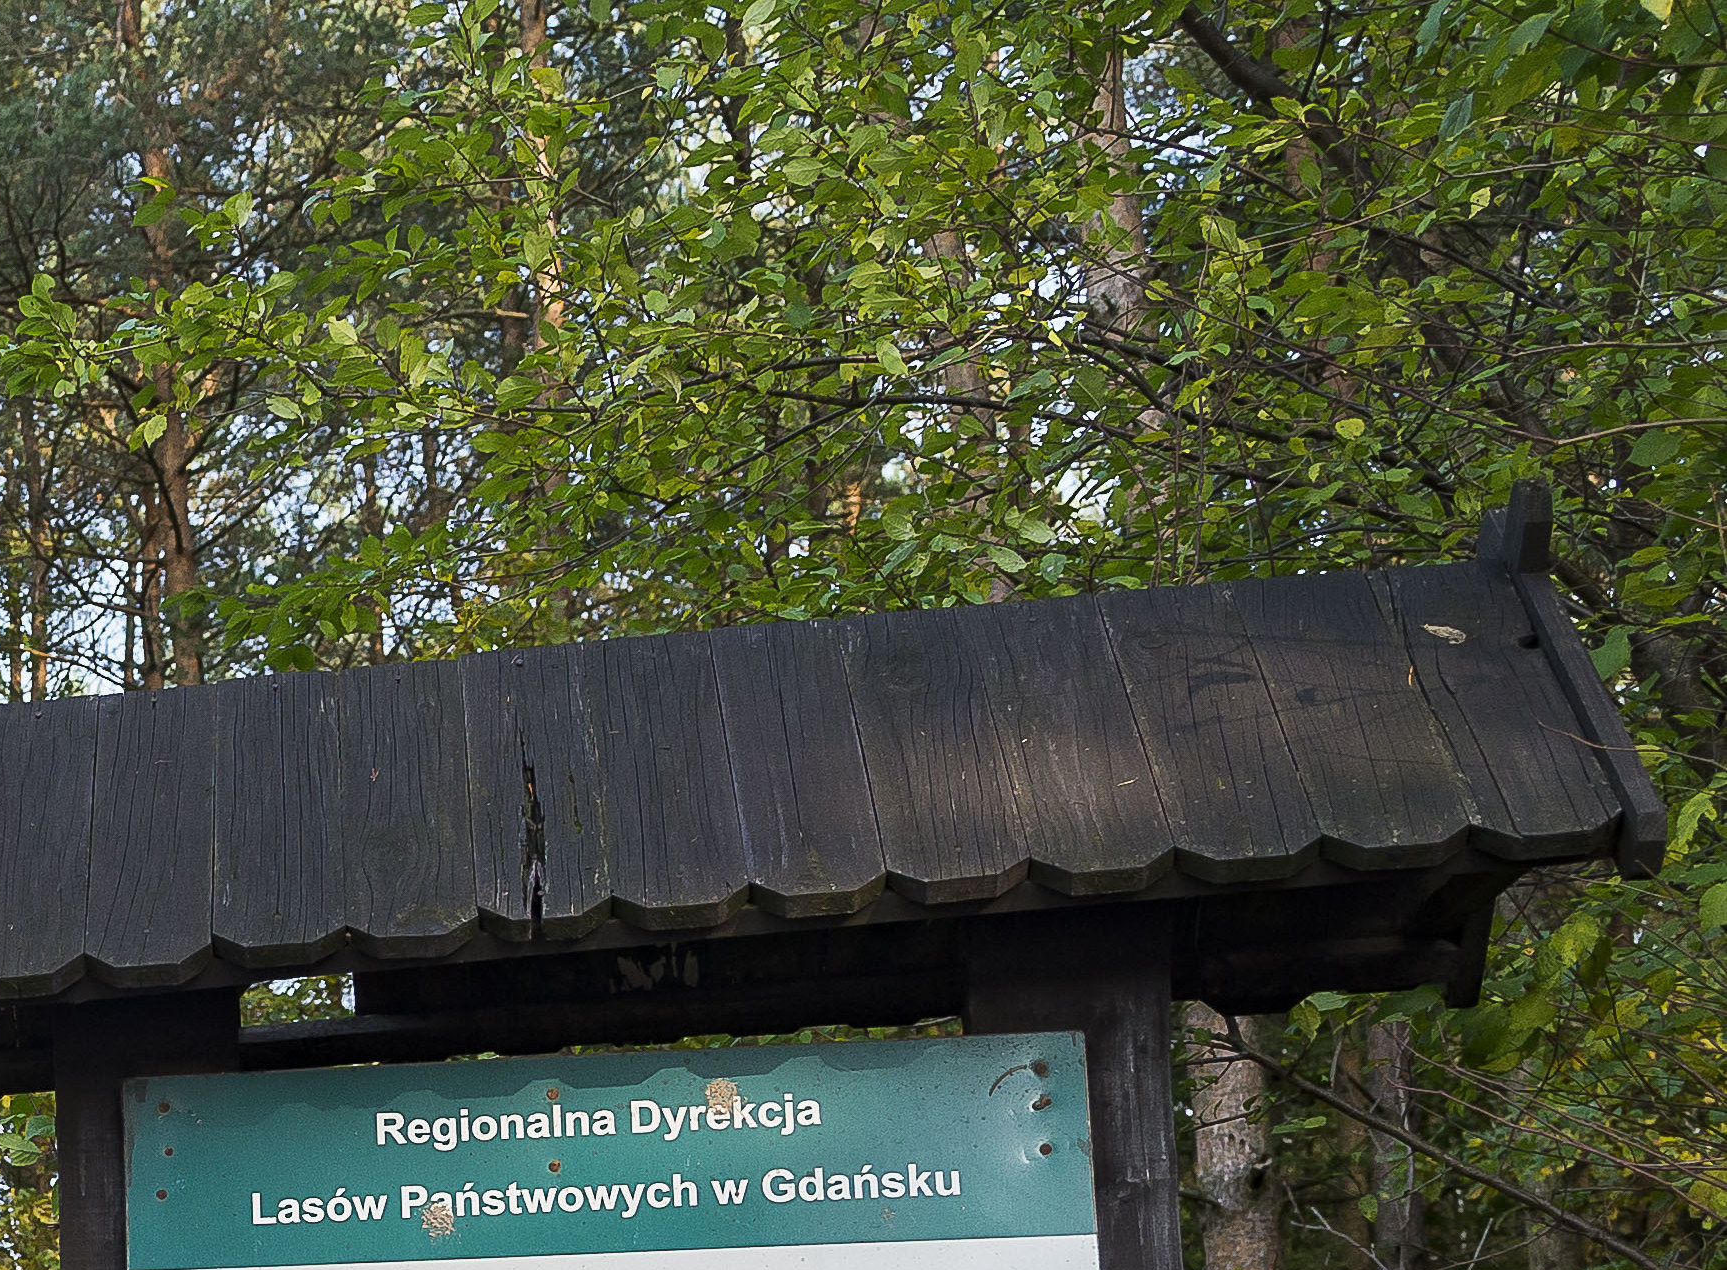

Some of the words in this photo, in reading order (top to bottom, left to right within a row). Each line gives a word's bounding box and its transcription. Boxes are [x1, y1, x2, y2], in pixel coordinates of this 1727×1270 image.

[375, 1104, 616, 1151] Regionalna
[630, 1094, 822, 1141] Dyrekcja
[251, 1188, 388, 1225] Lasów
[400, 1173, 699, 1220] Państwowych
[711, 1178, 749, 1206] w
[761, 1163, 962, 1204] Gdańsku
